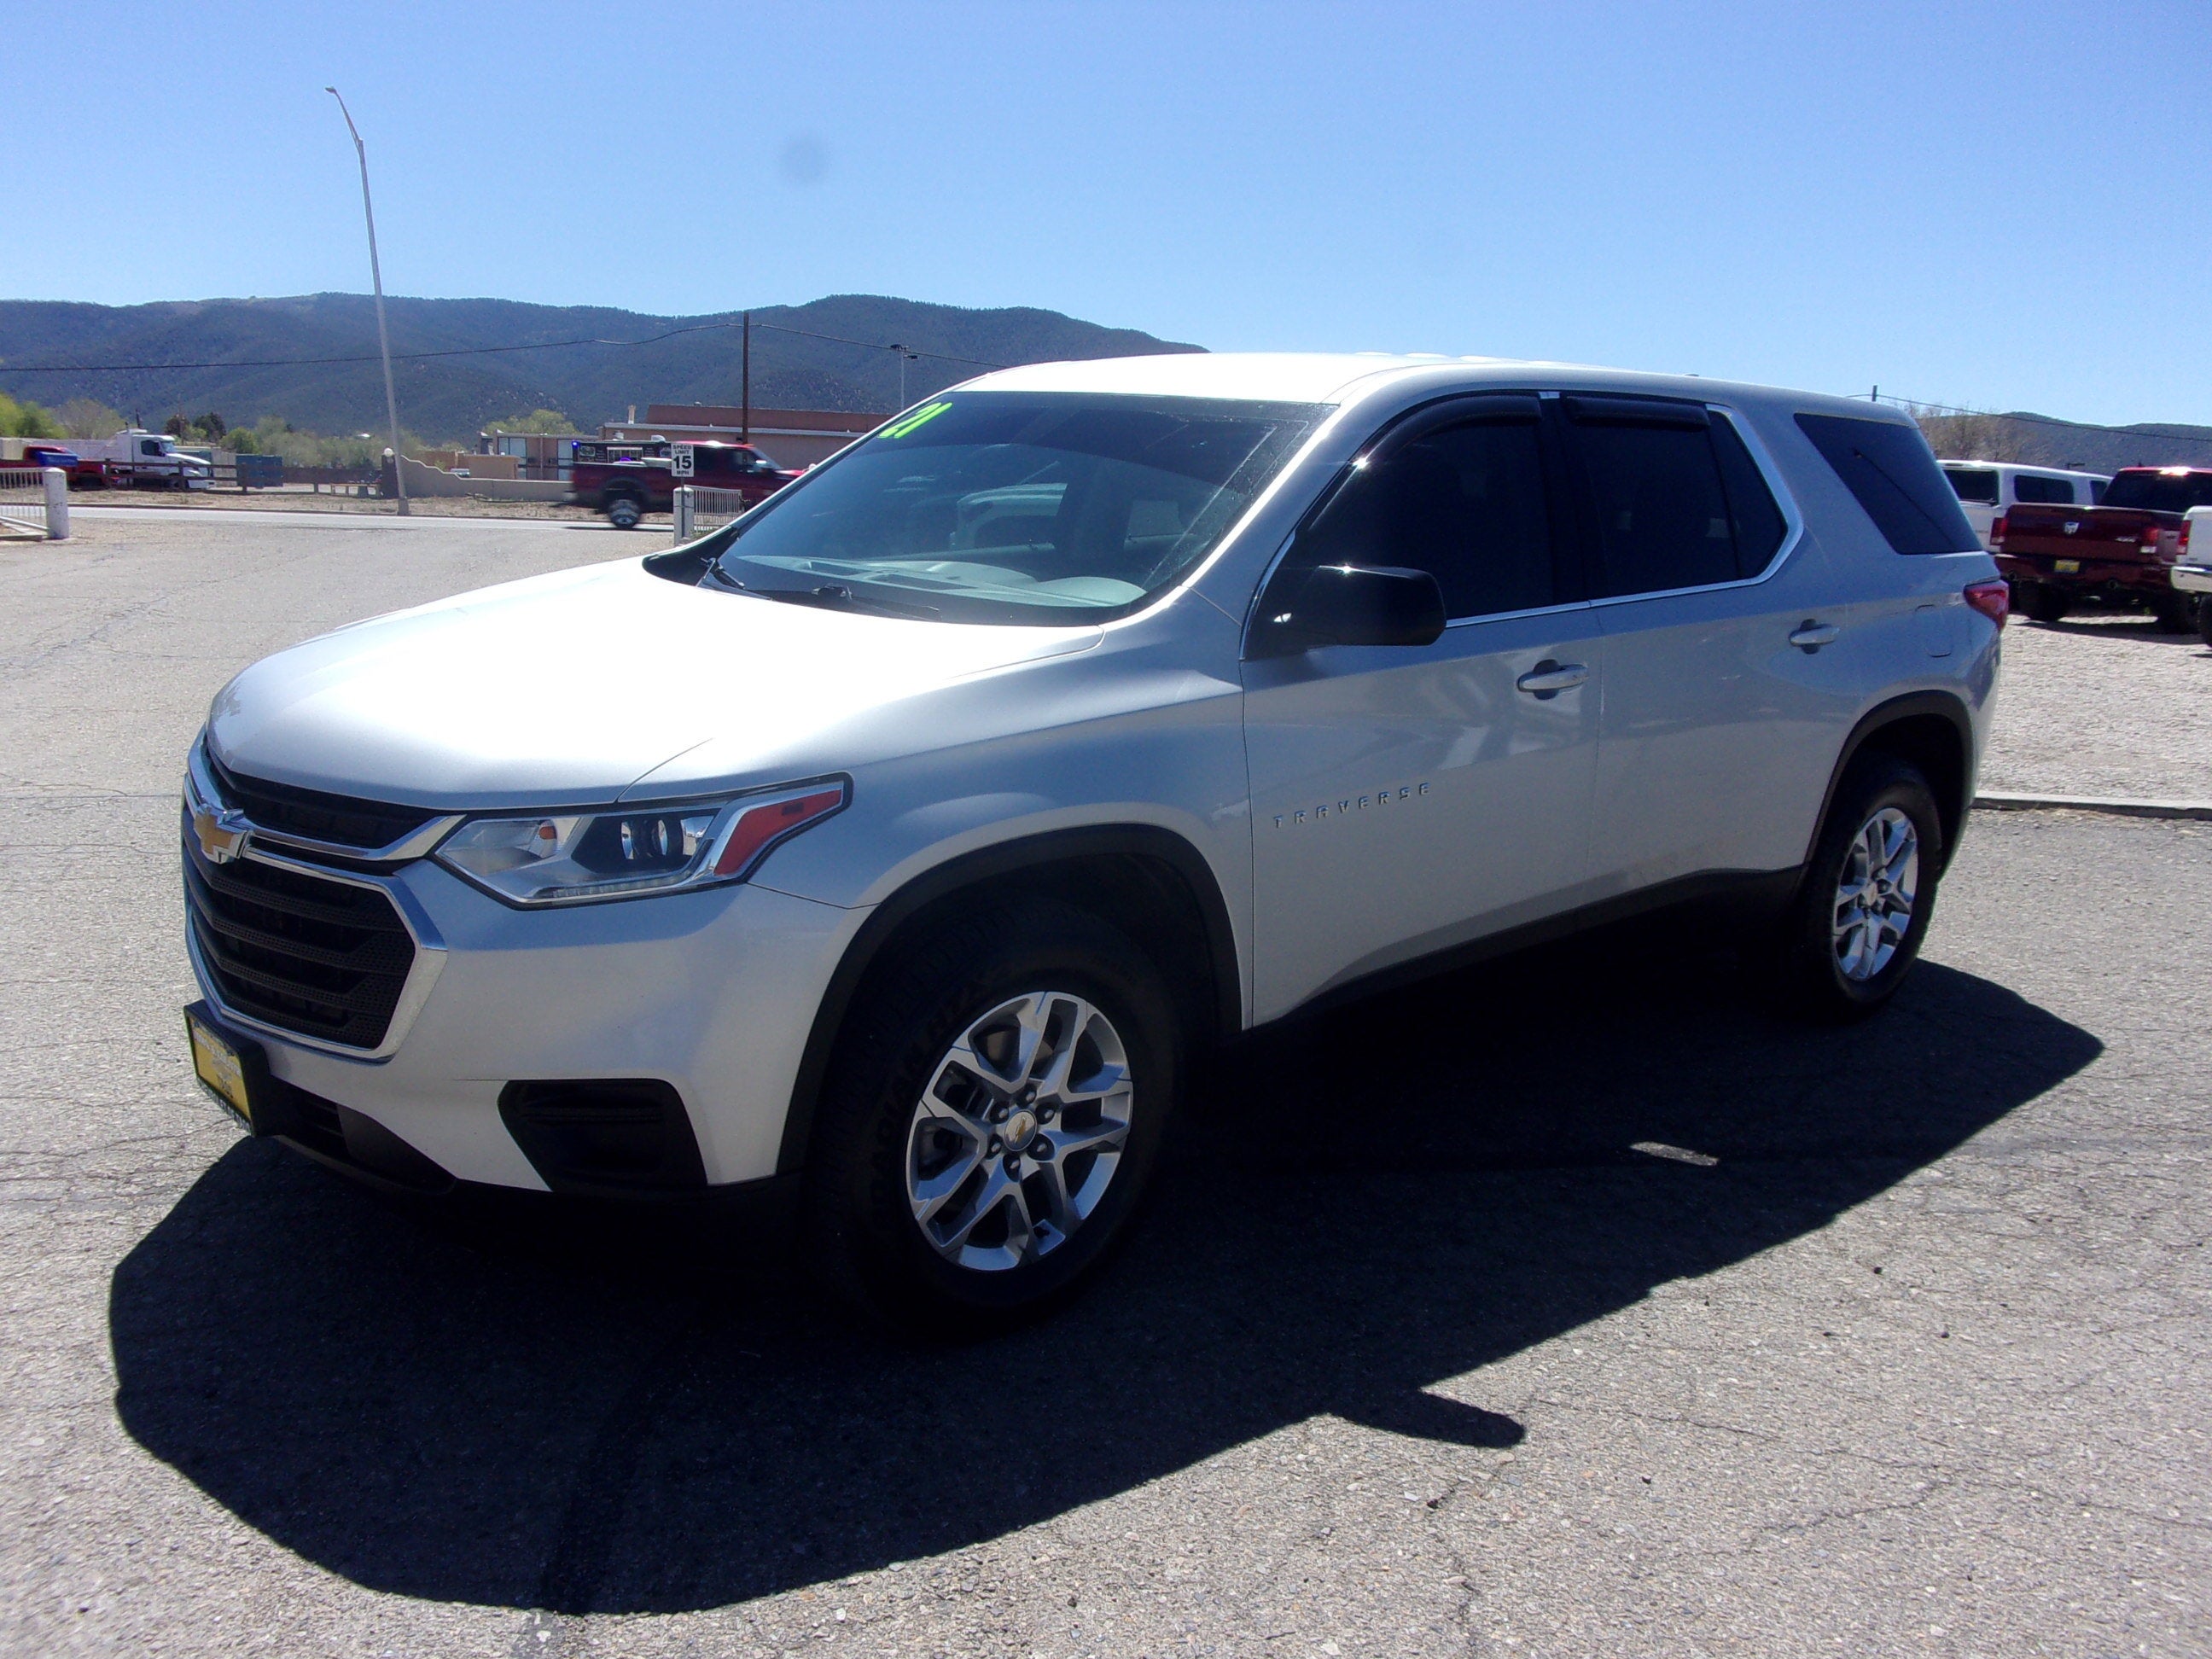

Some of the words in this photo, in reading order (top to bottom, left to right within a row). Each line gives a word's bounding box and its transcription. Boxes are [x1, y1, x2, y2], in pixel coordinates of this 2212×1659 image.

[876, 402, 953, 439] 21
[673, 456, 692, 469] 15
[1273, 782, 1431, 829] TRAVERSE
